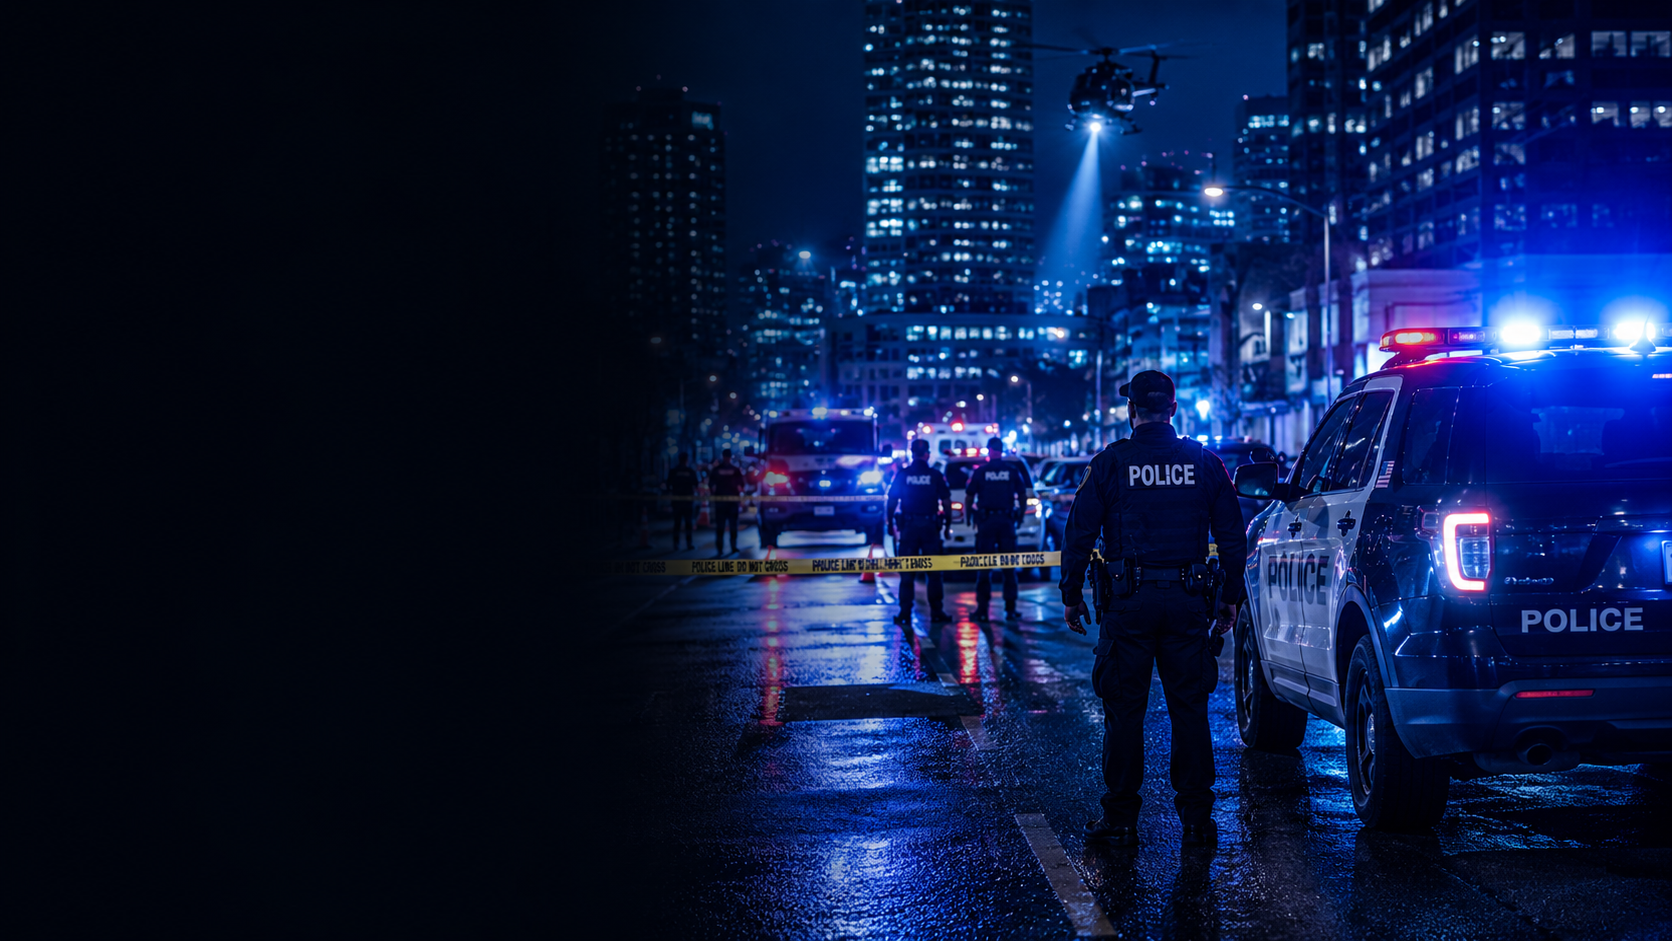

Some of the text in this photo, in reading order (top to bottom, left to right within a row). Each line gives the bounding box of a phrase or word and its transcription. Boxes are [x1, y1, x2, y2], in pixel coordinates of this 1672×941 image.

[1128, 463, 1196, 487] POLICE
[1268, 552, 1329, 605] POLICE
[1521, 607, 1644, 634] POLICE
